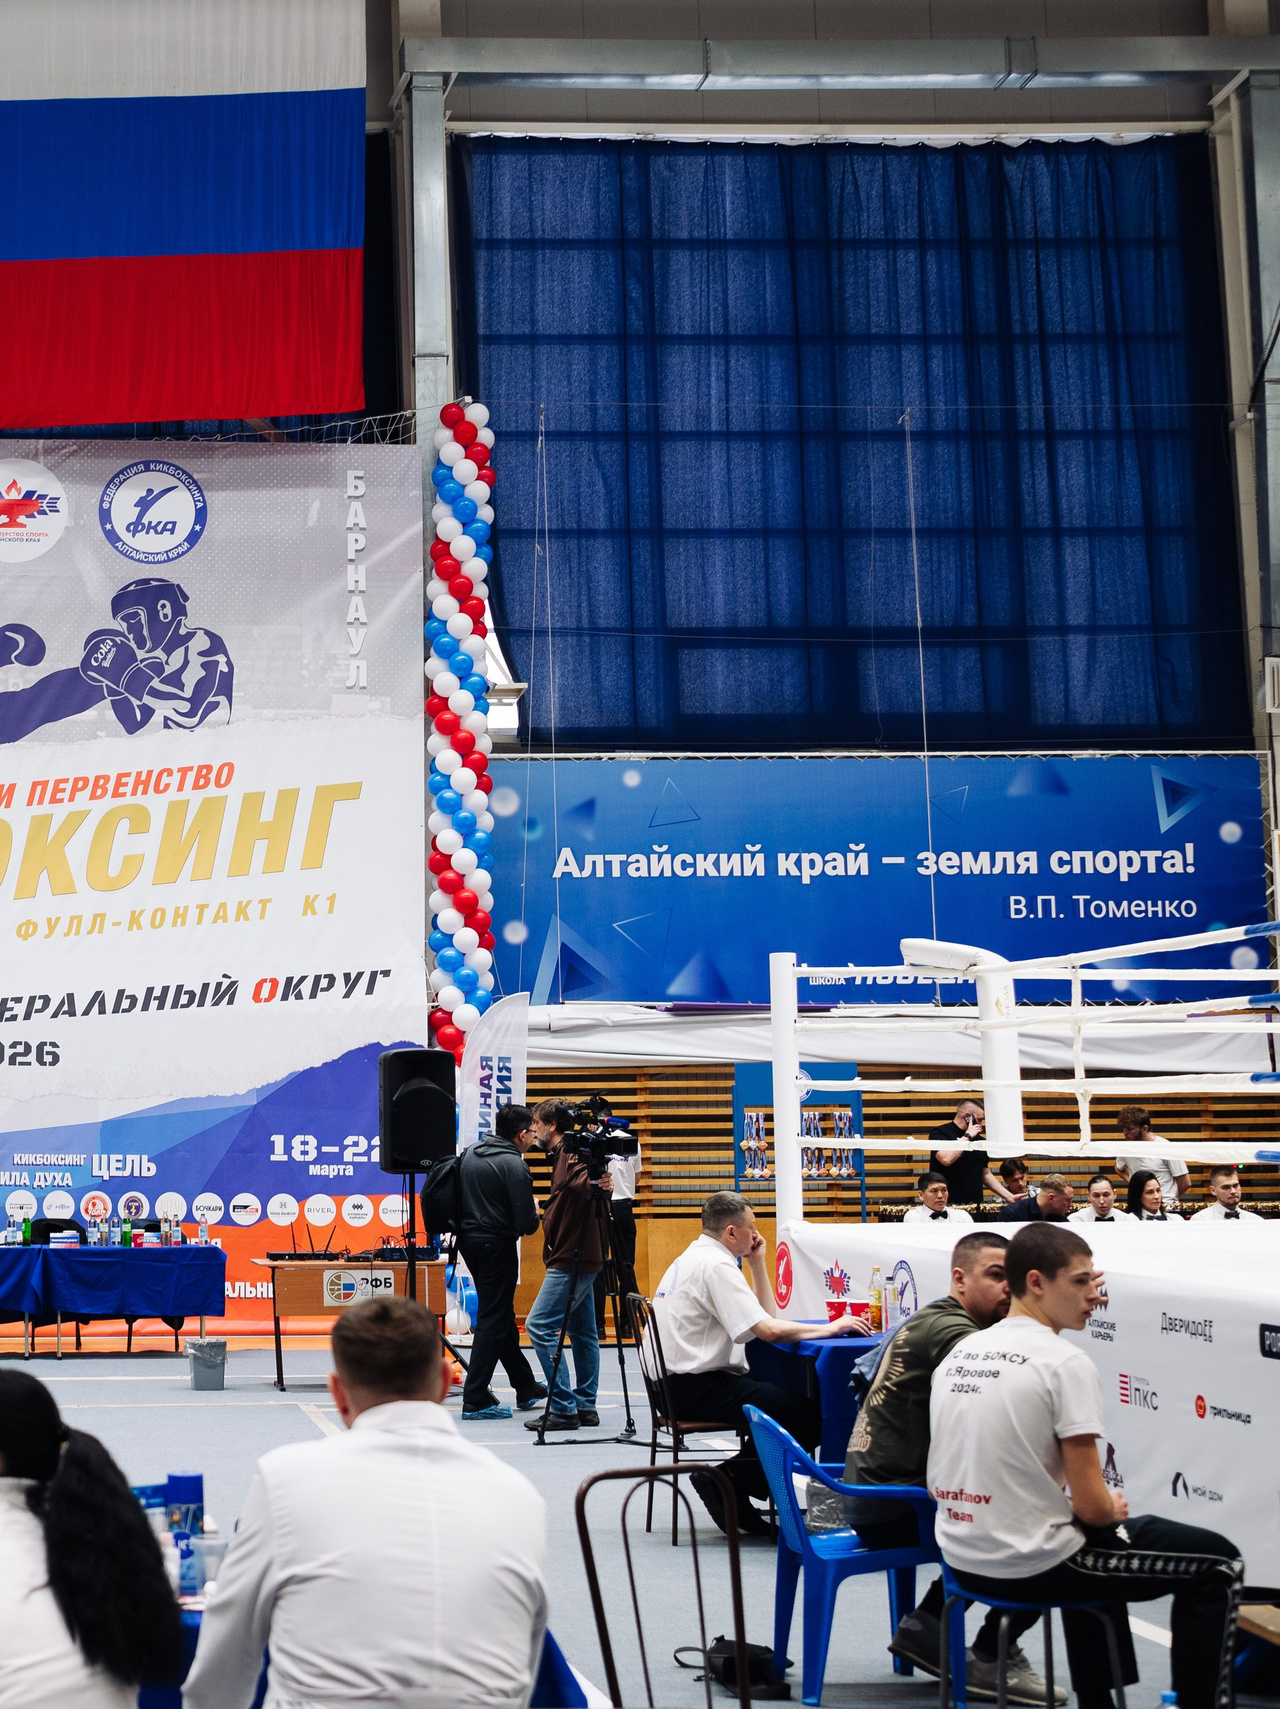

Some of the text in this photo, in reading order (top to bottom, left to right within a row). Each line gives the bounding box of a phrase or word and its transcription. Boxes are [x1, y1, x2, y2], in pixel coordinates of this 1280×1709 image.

[102, 462, 204, 509] ФЕДЕРАЦИЯ КИКБОКСИНГА
[125, 519, 177, 539] ФКА
[114, 540, 191, 562] АЛТАЙСКИЙ КРАЙ
[345, 470, 368, 690] БАРНАУЛ
[91, 639, 113, 667] Cola
[27, 762, 235, 807] ПЕРВЕНСТВО
[553, 843, 766, 880] Алтайский
[777, 843, 870, 885] край
[917, 851, 1040, 878] земля
[1050, 841, 1197, 884] спорта!
[16, 893, 339, 942] ФУЛЛ-КОНТАКТ К1
[1009, 894, 1198, 921] В.П. Томенко
[251, 969, 393, 1005] ОКРУГ
[13, 1153, 86, 1166] КИКБОКСИНГ
[92, 1154, 157, 1180] ЦЕЛЬ
[308, 1164, 354, 1178] марта
[33, 1172, 73, 1188] ДУХА
[1088, 1317, 1116, 1332] АЛТАЙСКИЕ
[1091, 1330, 1114, 1343] КАРЬЕРЫ
[963, 1352, 979, 1361] по
[981, 1351, 1031, 1365] БОКСУ
[1133, 1387, 1158, 1411] ПКС
